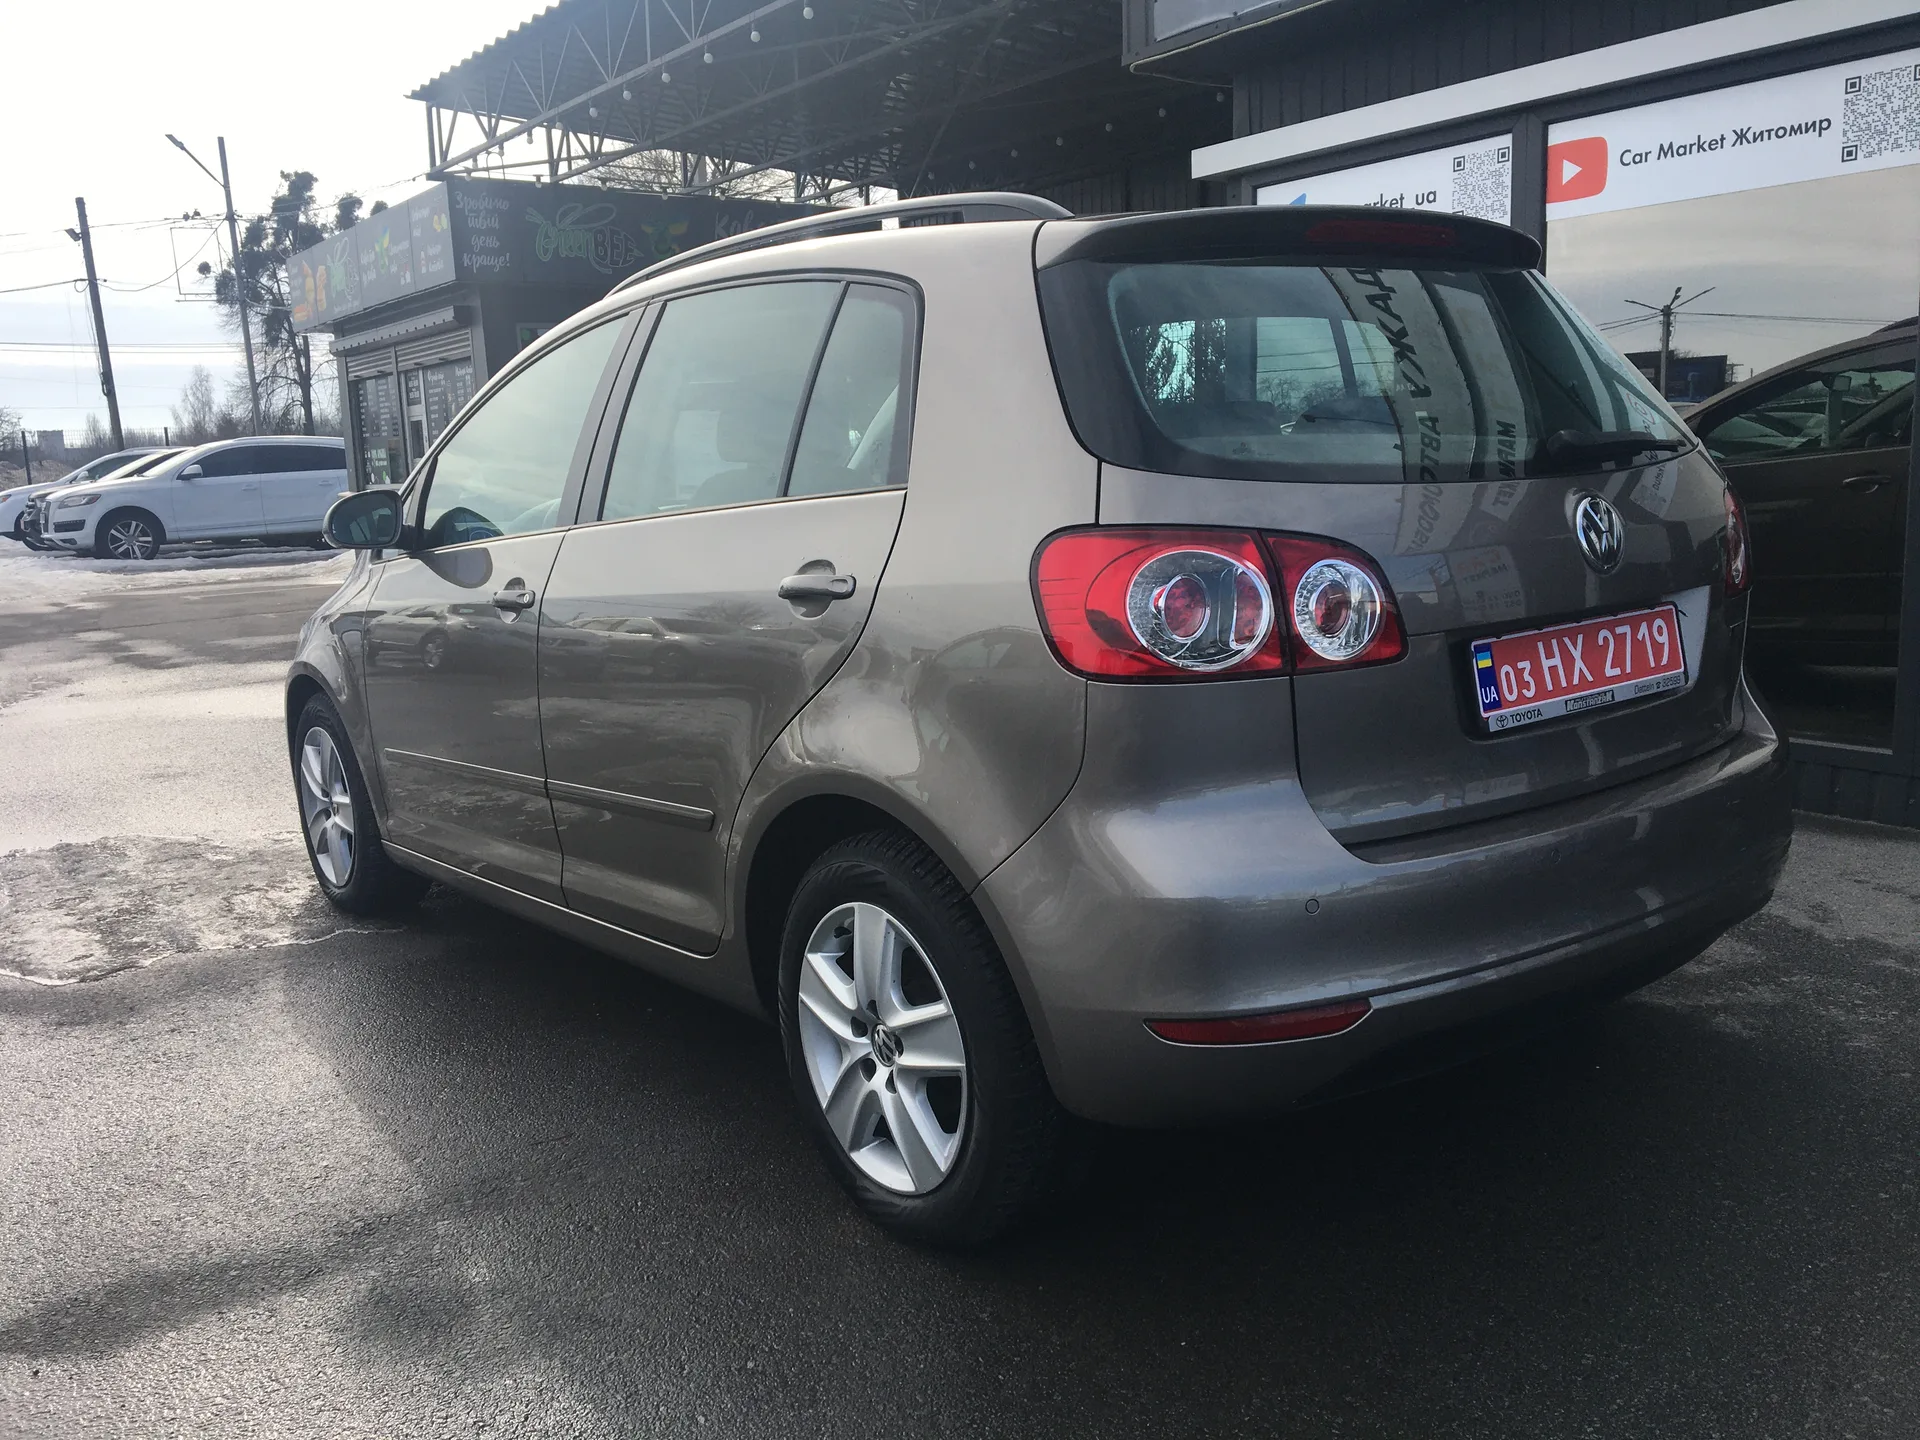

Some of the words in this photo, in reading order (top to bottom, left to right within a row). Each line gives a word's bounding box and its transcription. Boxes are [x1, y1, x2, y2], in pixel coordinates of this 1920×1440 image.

[1619, 149, 1652, 167] Car
[1656, 134, 1726, 161] Market
[1731, 117, 1832, 148] Житомир
[455, 191, 510, 216] Зробимо
[471, 234, 500, 253] день
[462, 252, 510, 274] краще!
[1501, 660, 1537, 702] 03
[1537, 634, 1594, 692] HX
[1597, 618, 1670, 678] 2719
[1481, 685, 1499, 704] UA
[1509, 708, 1543, 724] TOYOTA
